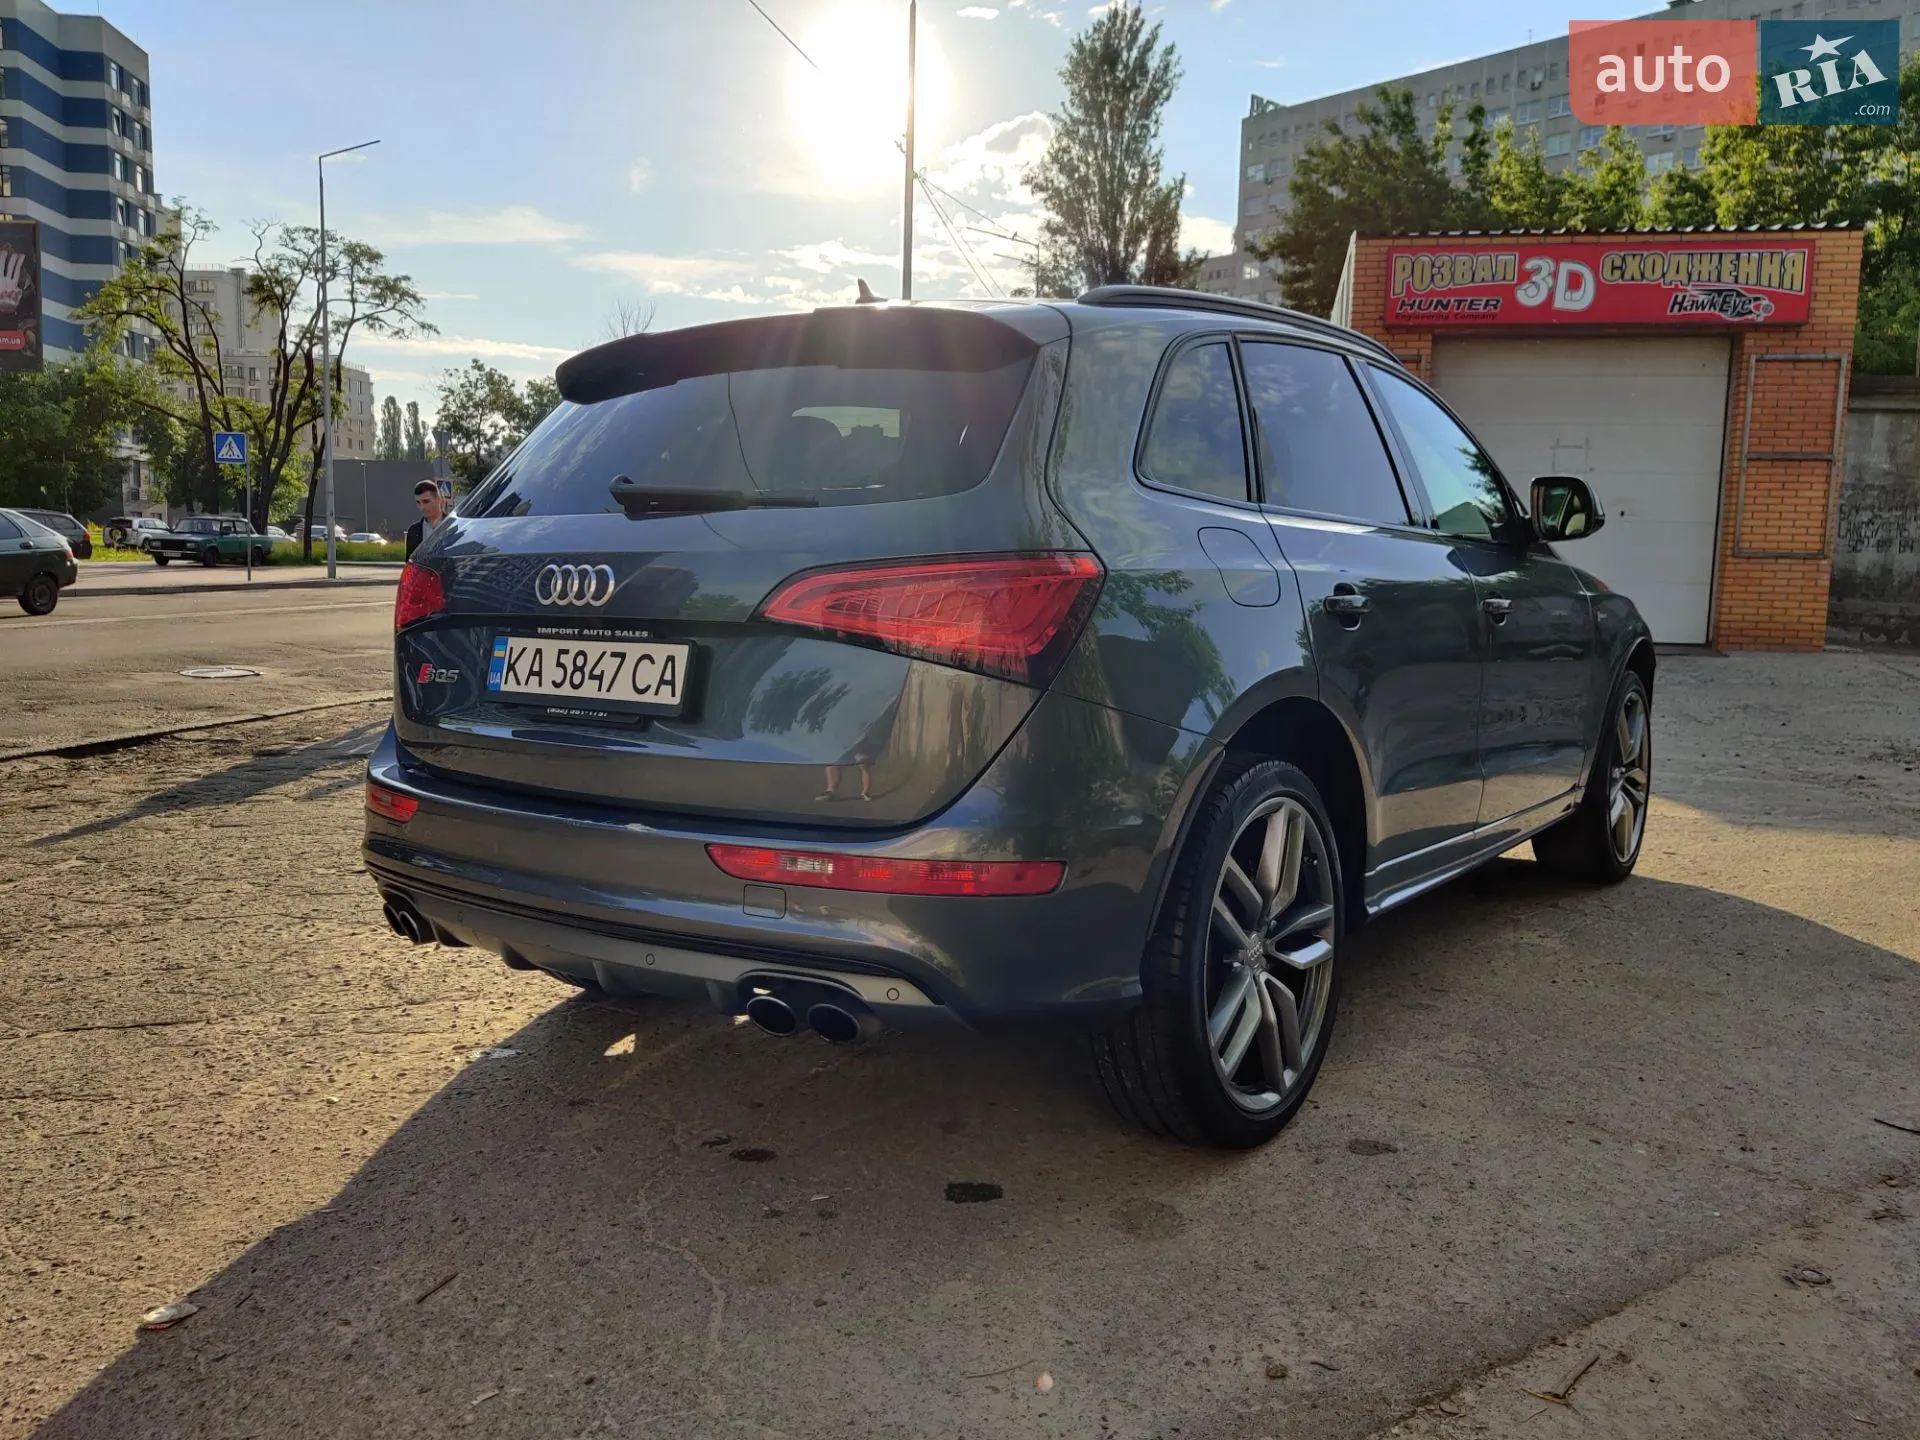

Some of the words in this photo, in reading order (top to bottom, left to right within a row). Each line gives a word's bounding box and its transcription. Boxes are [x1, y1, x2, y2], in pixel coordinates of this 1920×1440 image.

[1391, 253, 1518, 297] РОЗВАЛ
[1515, 256, 1596, 312] 3D
[1600, 250, 1806, 294] СХОДЖЕННЯ
[1397, 298, 1501, 313] HUNTER
[1669, 292, 1752, 317] HawkEye
[537, 627, 580, 635] IMPORT
[583, 628, 612, 636] AUTO
[614, 630, 649, 638] SALES
[422, 665, 460, 683] SQ5
[488, 671, 501, 685] UA
[504, 646, 542, 687] KA
[551, 648, 627, 693] 5847
[631, 653, 676, 698] CA
